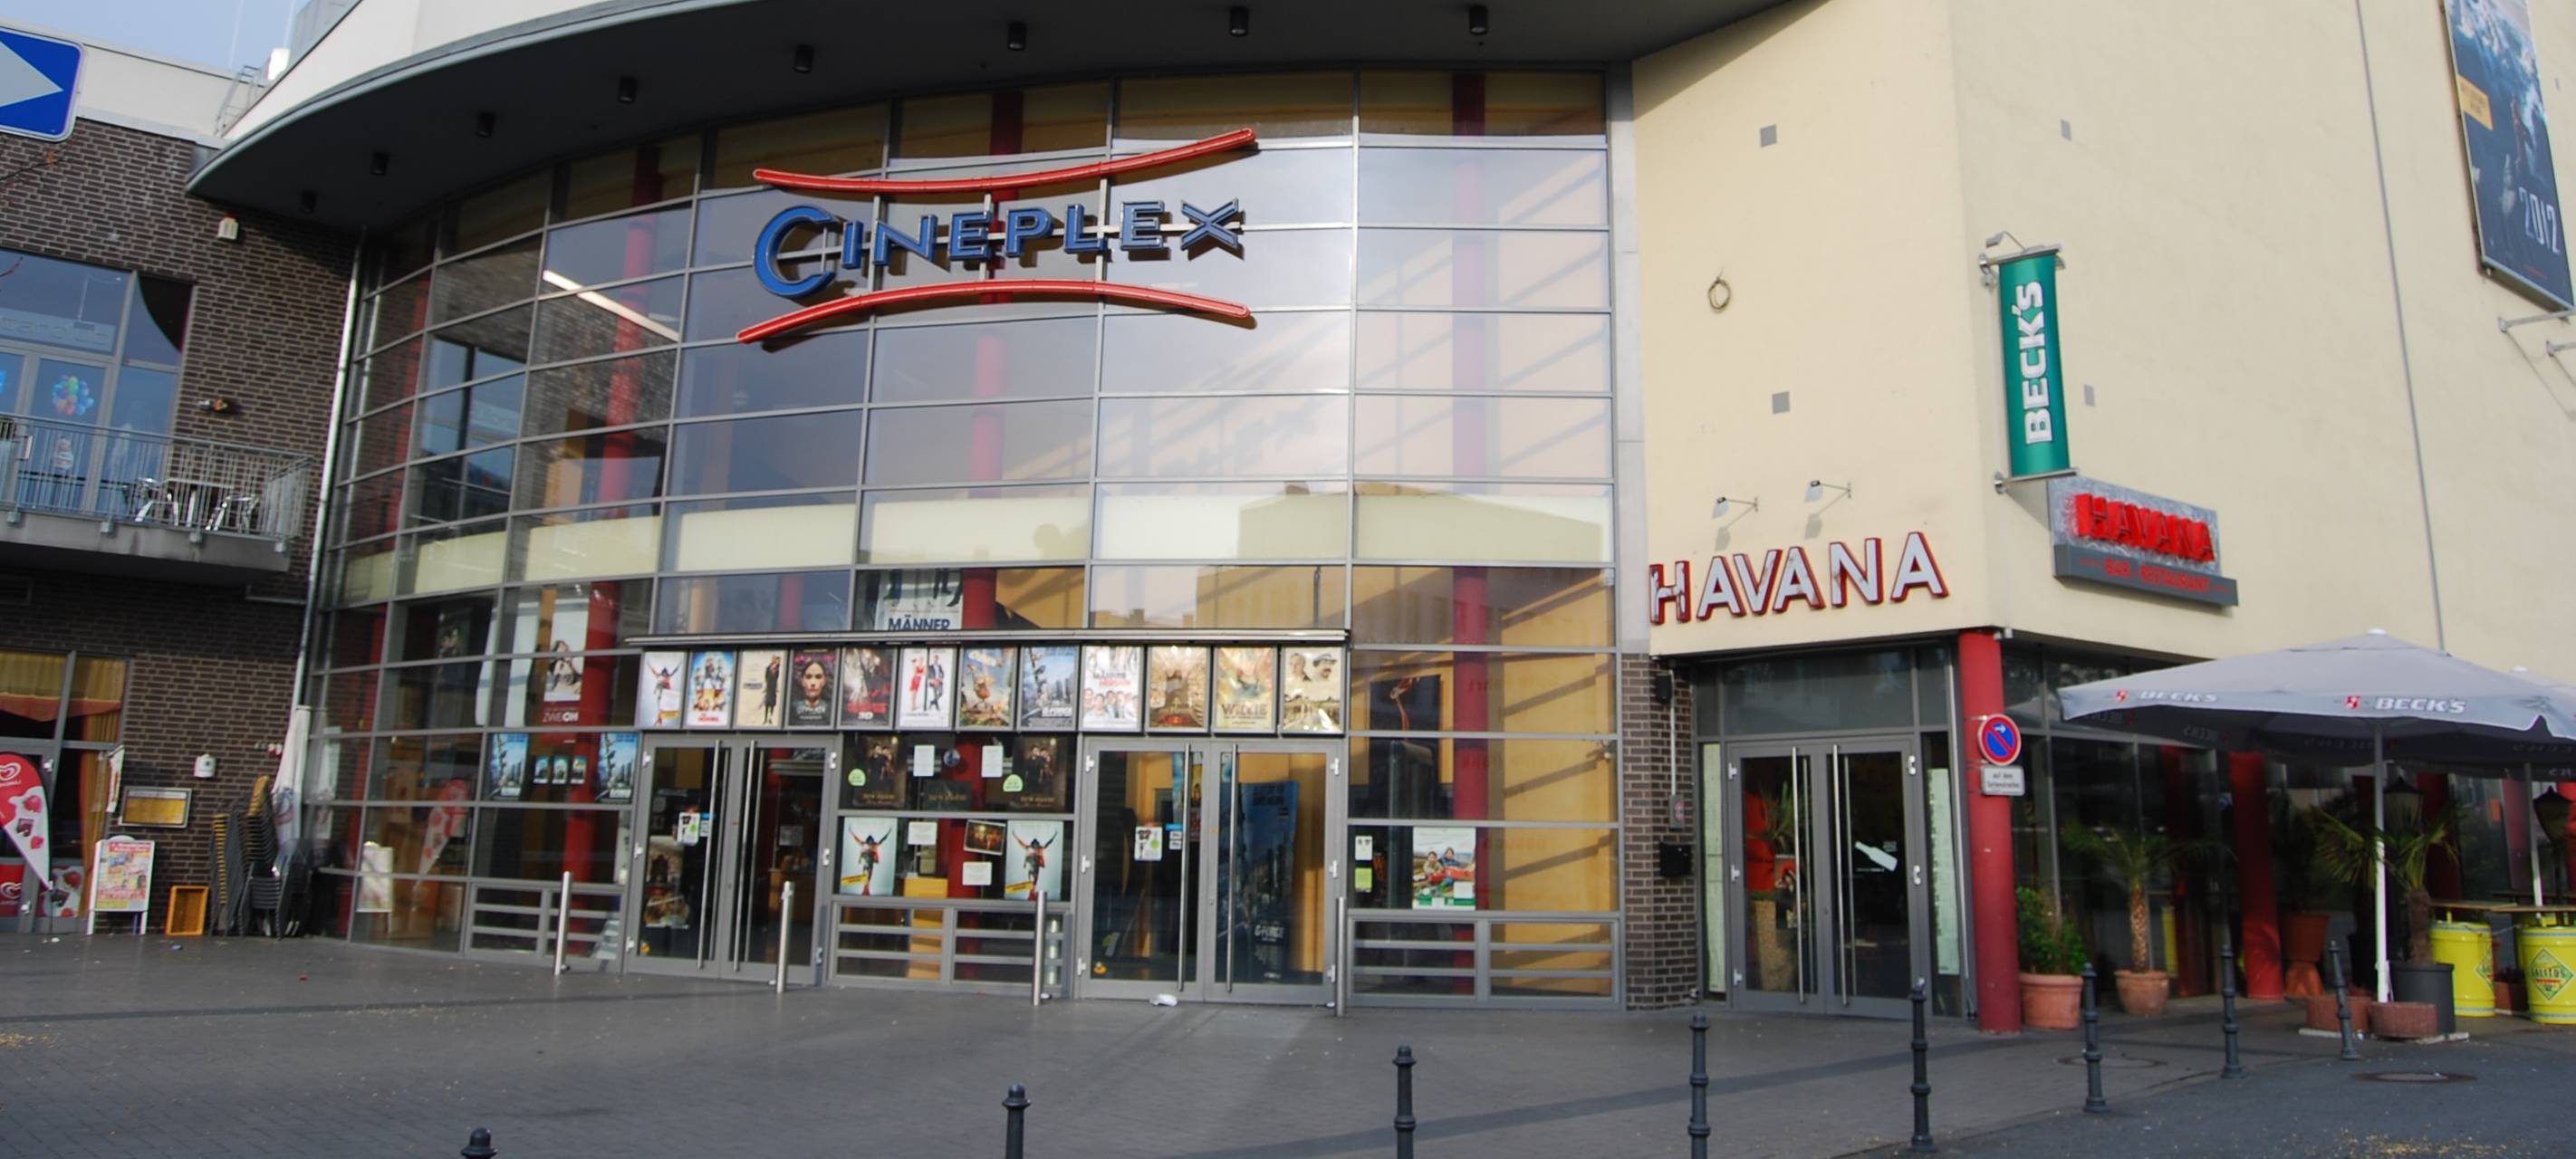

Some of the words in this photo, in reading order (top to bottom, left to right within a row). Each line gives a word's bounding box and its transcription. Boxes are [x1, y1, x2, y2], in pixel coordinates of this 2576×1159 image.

[753, 197, 1240, 298] CINEPLEX
[2518, 187, 2561, 254] 2012
[2011, 281, 2053, 445] BECK'S
[2073, 493, 2216, 562] HAVANA
[1648, 531, 1949, 625] HAVANA
[888, 614, 950, 631] MÄNNER
[2375, 696, 2466, 714] BECK'S
